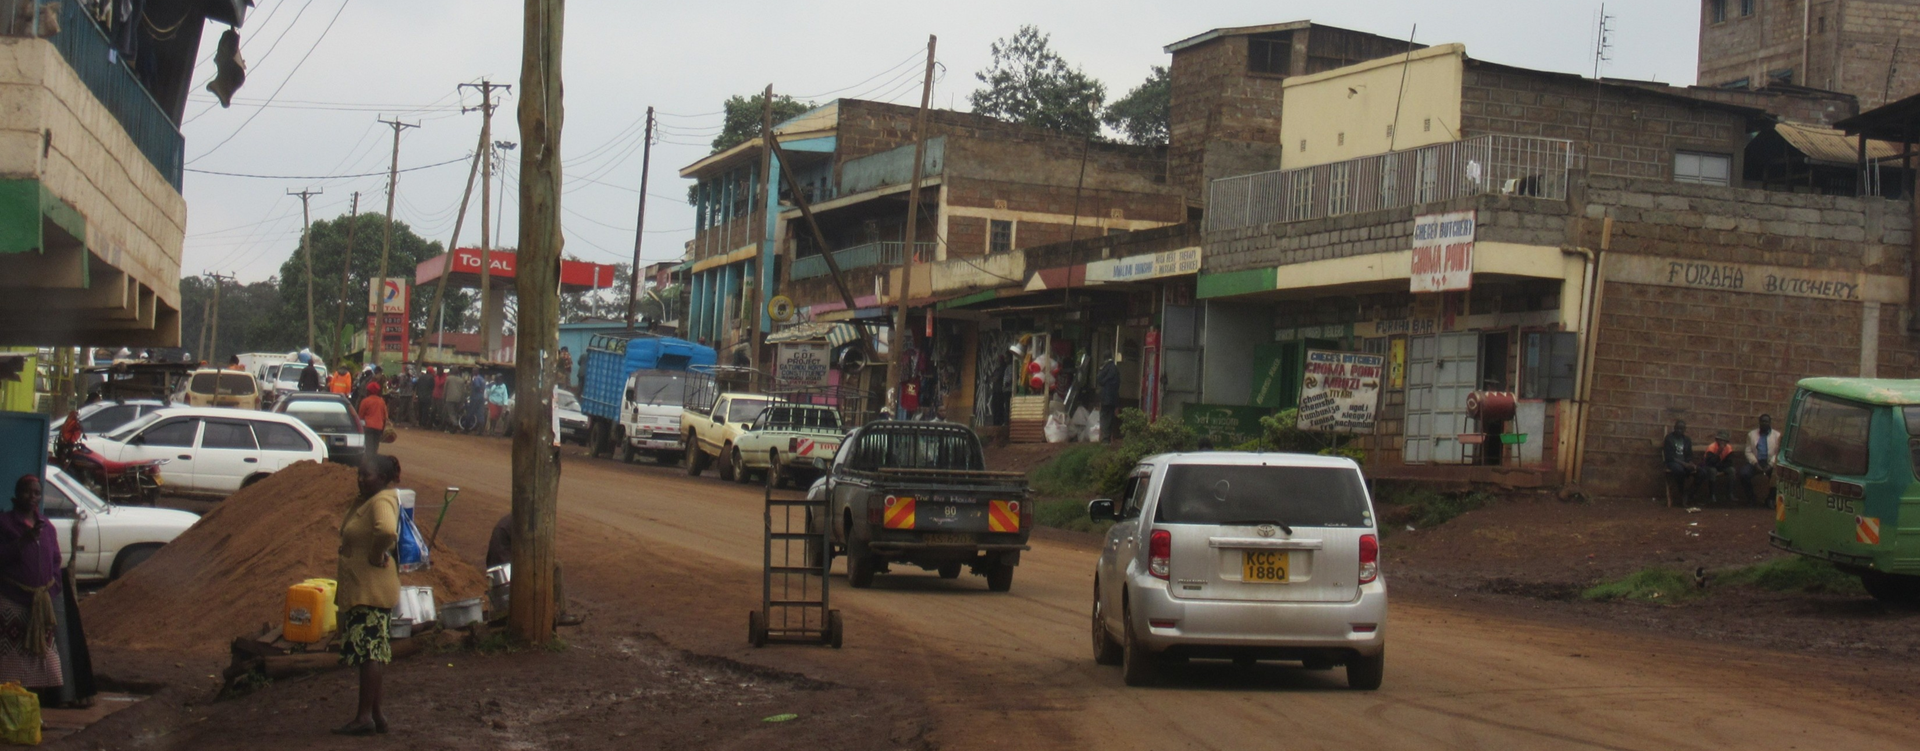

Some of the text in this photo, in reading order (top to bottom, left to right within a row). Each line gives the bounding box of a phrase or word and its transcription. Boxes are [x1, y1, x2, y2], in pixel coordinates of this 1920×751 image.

[1439, 220, 1473, 238] BUTCHERY
[460, 253, 512, 270] TOAL
[1411, 241, 1472, 275] CHOMA POINT
[1668, 261, 1744, 289] FURAHA
[371, 304, 403, 312] TTAL
[1376, 320, 1433, 334] FURAHA BAR
[1342, 355, 1381, 364] BUTCHERY
[1305, 362, 1381, 378] CHOMA POINT
[1300, 397, 1335, 413] chemsha
[1303, 392, 1328, 404] choma
[944, 506, 957, 516] 80
[1827, 495, 1854, 514] BUS
[1246, 552, 1275, 566] KCC
[1248, 566, 1286, 580] 188Q
